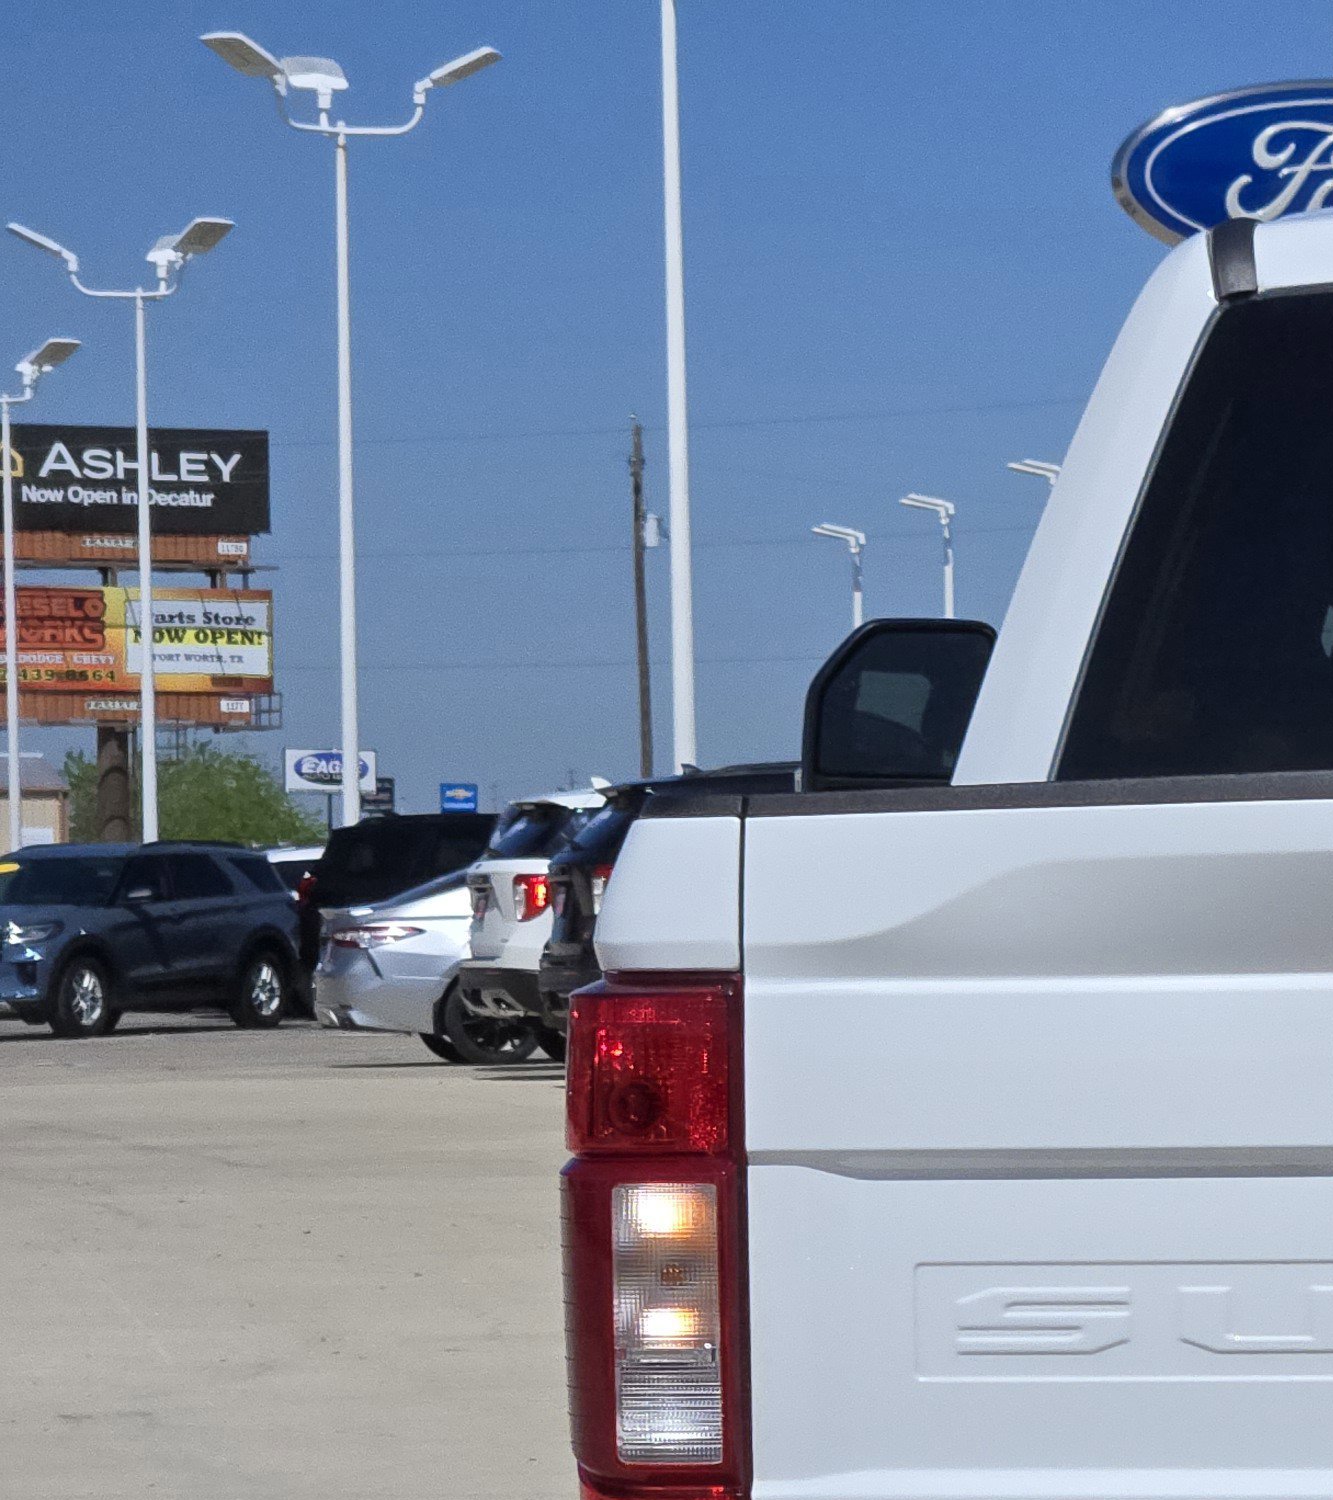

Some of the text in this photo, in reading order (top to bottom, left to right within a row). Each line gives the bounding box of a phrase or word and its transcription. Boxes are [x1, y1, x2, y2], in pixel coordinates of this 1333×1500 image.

[38, 442, 242, 483] ASHLEY
[22, 485, 64, 504] Now
[67, 486, 118, 507] Open
[121, 486, 139, 505] in
[152, 611, 256, 626] arts Store
[194, 629, 263, 646] OPEN!
